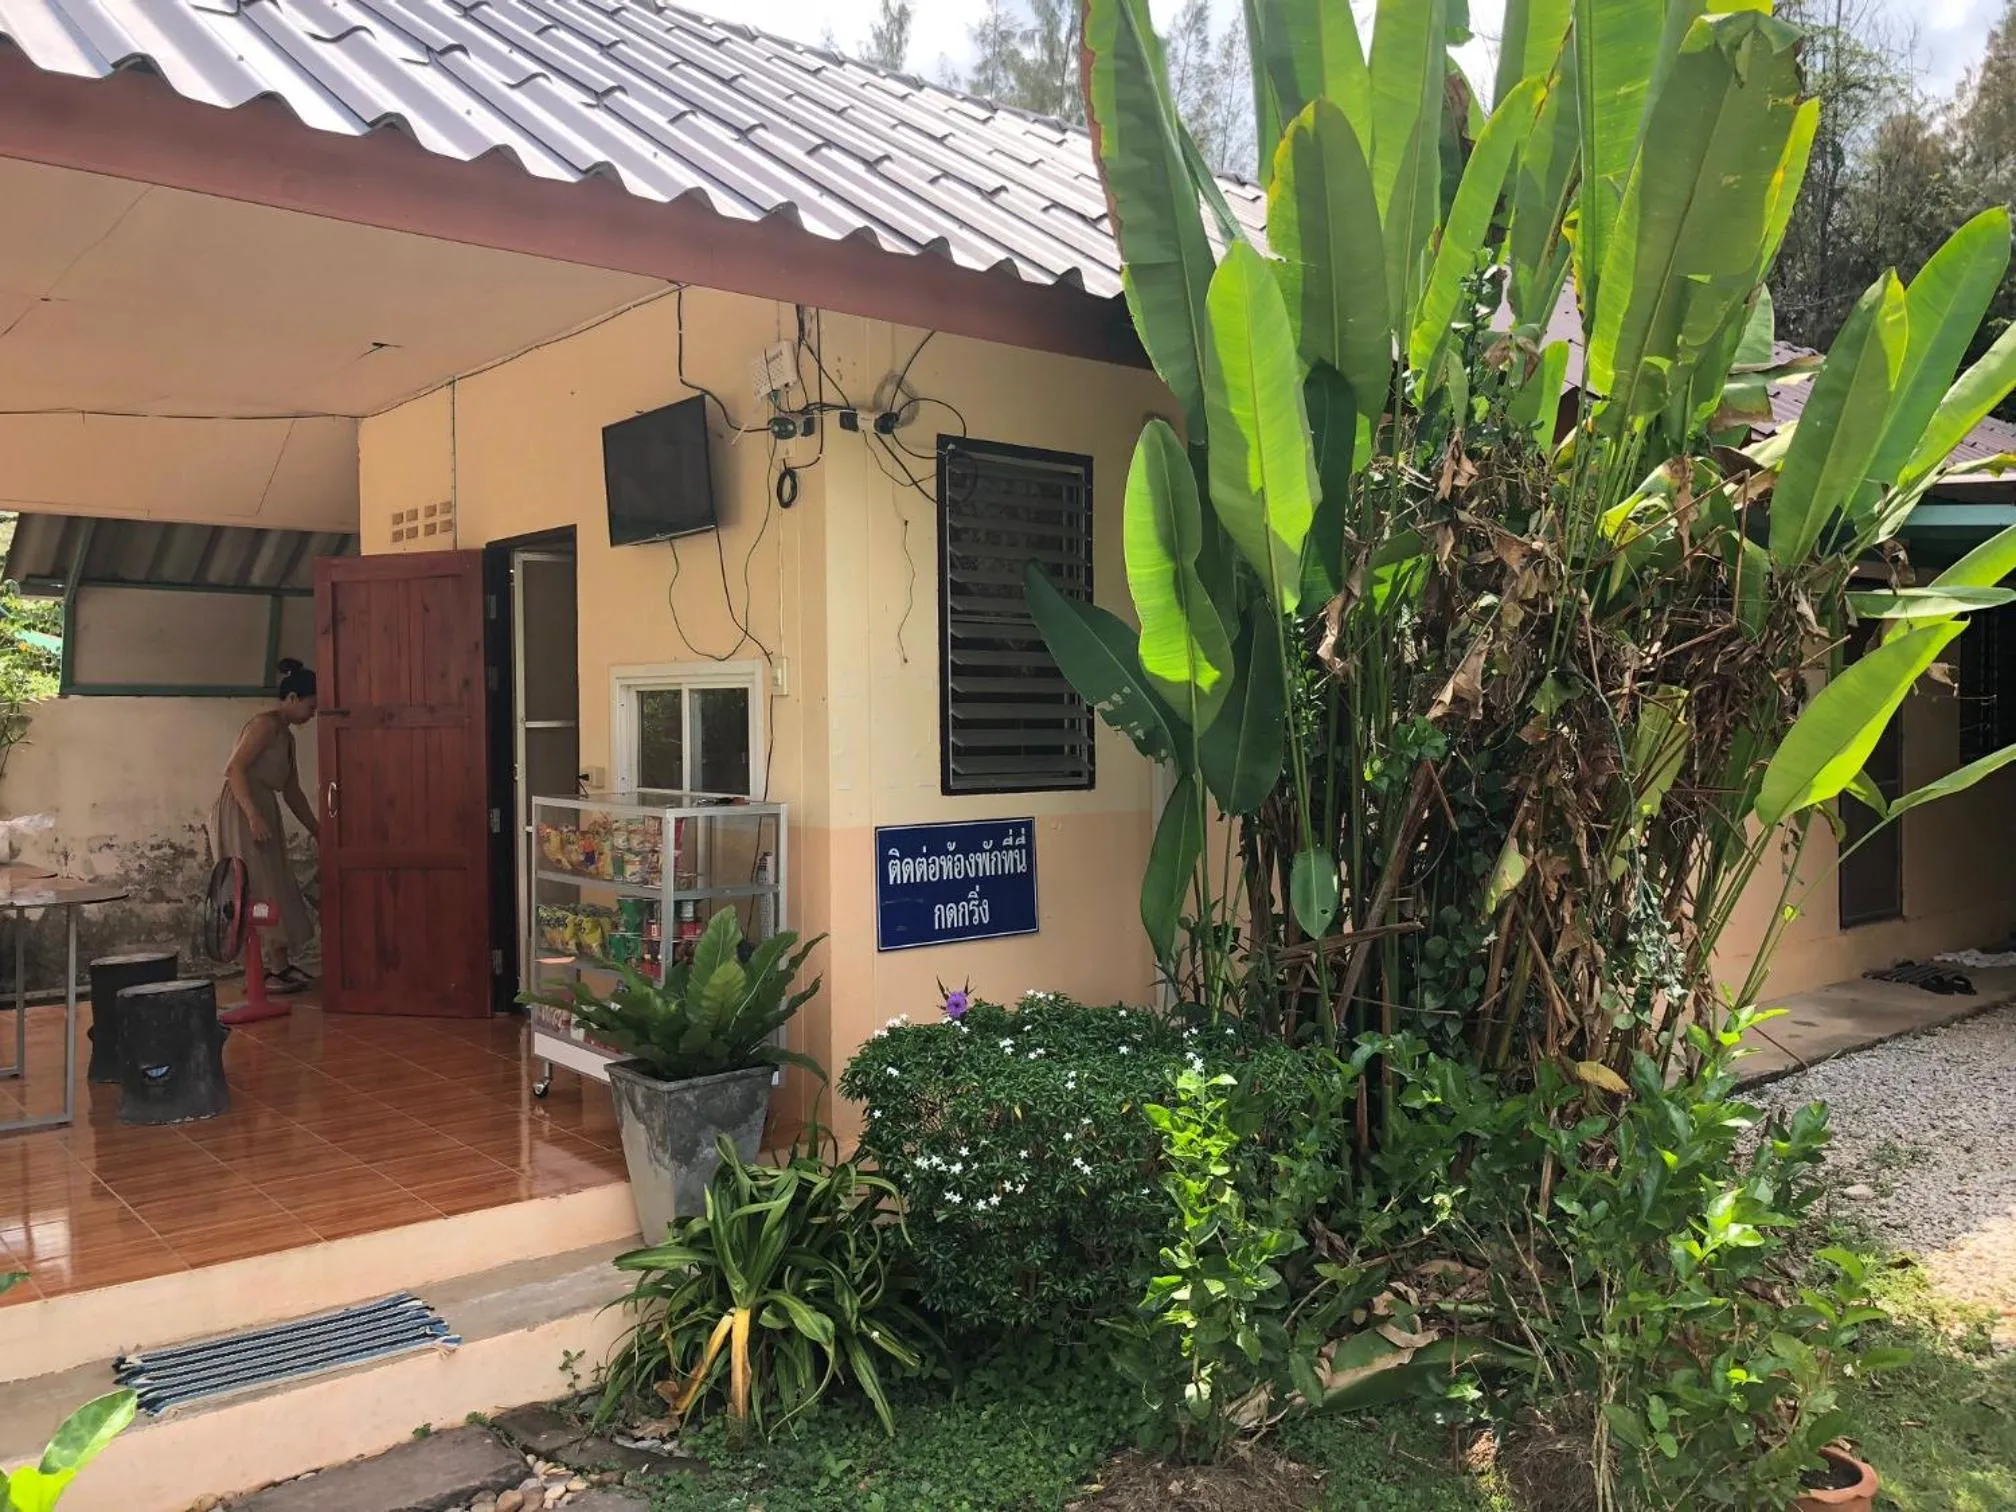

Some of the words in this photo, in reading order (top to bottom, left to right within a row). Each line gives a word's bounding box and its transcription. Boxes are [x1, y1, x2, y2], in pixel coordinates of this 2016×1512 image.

[887, 827, 1026, 885] ติดต่อห้องพักที่นี่
[934, 885, 989, 930] กดกริ่ง
